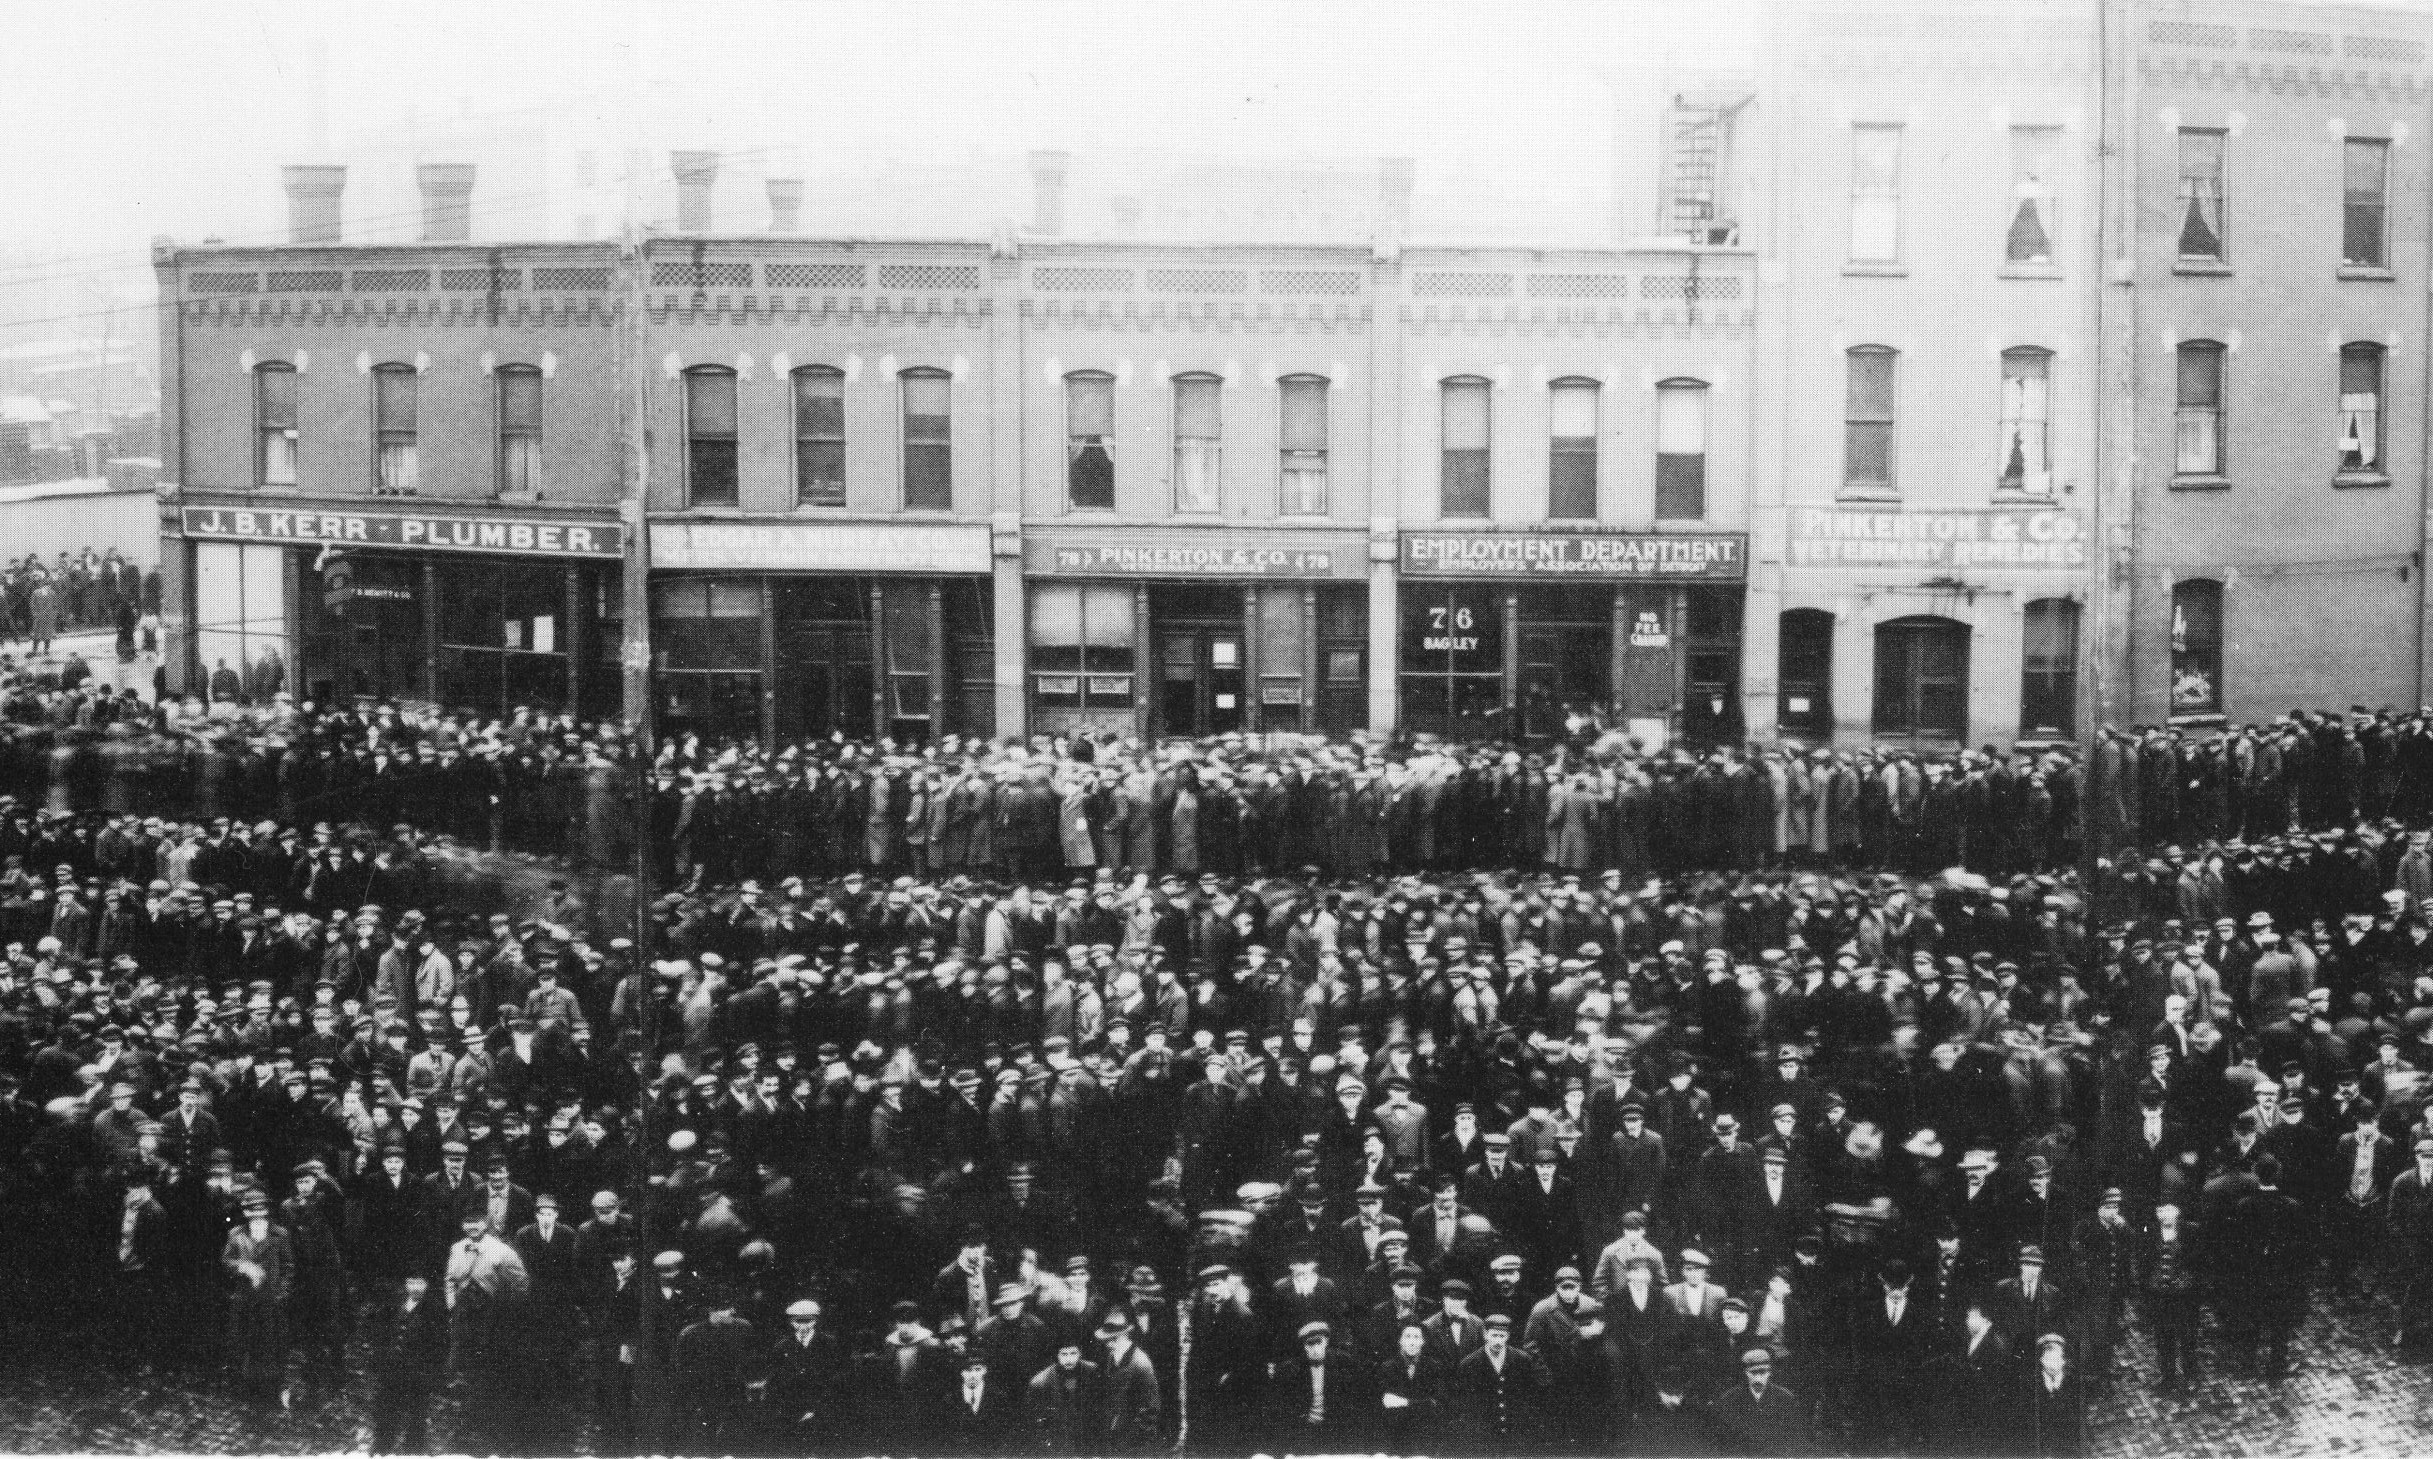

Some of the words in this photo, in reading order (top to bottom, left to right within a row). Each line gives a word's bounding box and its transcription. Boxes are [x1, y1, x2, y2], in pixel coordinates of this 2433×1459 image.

[271, 513, 368, 540] KERR
[1802, 510, 1979, 539] PINKERTON
[1991, 514, 2020, 541] &
[1100, 547, 1223, 565] PINKERTON
[1231, 550, 1248, 565] &
[1411, 538, 1570, 560] EMPLOYMENT
[1794, 540, 1945, 562] VETERINARY
[1423, 636, 1479, 650] BAGLEY
